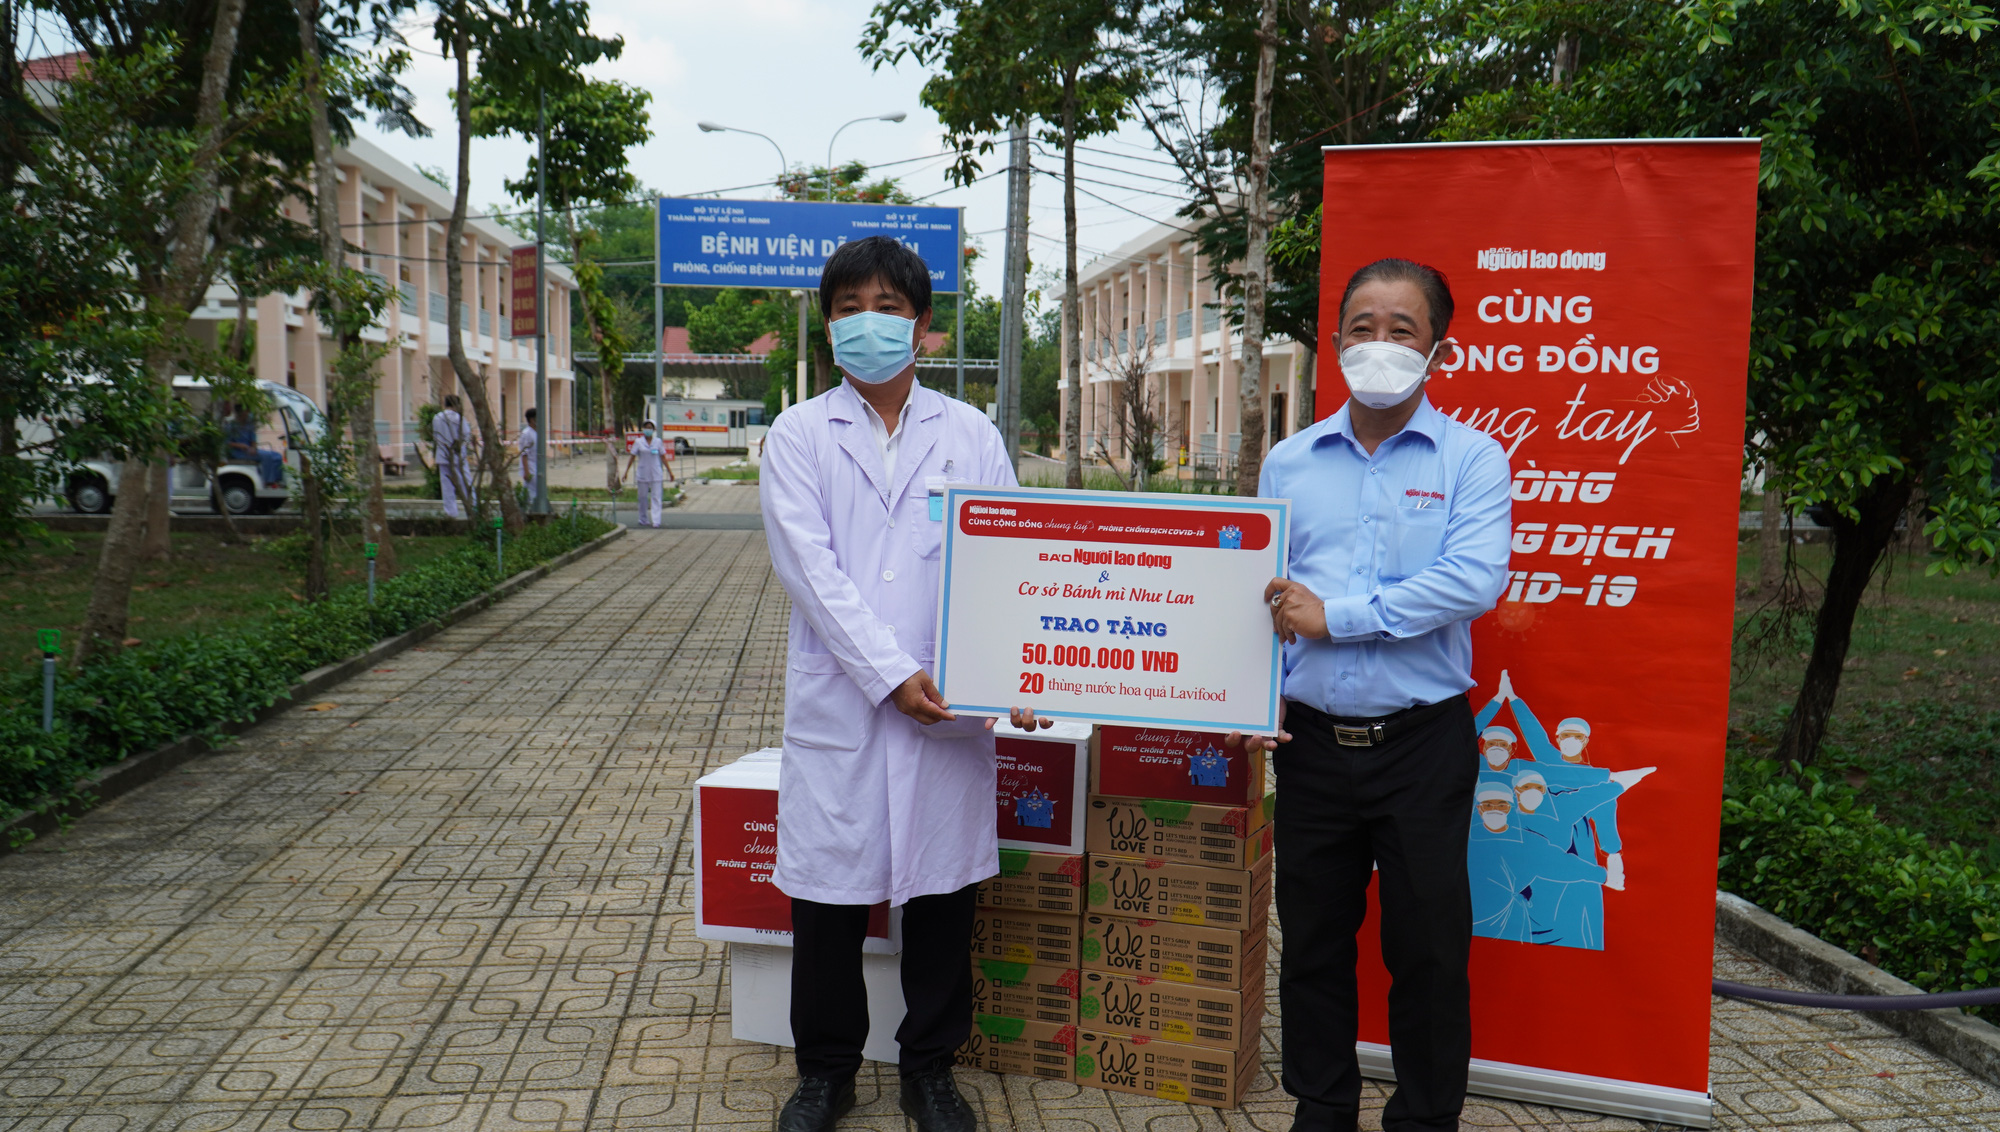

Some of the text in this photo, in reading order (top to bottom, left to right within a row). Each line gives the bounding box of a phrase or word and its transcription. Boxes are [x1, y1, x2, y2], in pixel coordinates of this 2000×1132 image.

[667, 214, 696, 222] THÀNH
[698, 214, 716, 222] PHỐ
[732, 216, 746, 224] CHÍ
[694, 206, 706, 214] BỘ
[721, 206, 744, 215] LỆNH
[914, 222, 928, 230] CHÍ
[701, 231, 759, 258] BỆNH
[766, 234, 815, 260] VIỆN
[673, 261, 710, 274] PHÒNG,
[712, 261, 747, 274] CHỐNG
[750, 264, 777, 276] BỆNH
[780, 264, 805, 276] VIÊM
[1530, 250, 1558, 269] lao
[1478, 288, 1592, 324] CÙNG
[1439, 334, 1660, 379] ỘNG ĐỒNG
[1556, 383, 1656, 465] tay
[1510, 460, 1616, 504] ÒNG
[988, 506, 1000, 515] lao
[968, 517, 992, 526] CÙNG
[993, 518, 1016, 528] CỘNG
[1018, 519, 1042, 528] ĐỒNG
[1044, 518, 1072, 532] chung
[1073, 520, 1088, 534] tay
[1098, 524, 1124, 532] PHÒNG
[1125, 525, 1150, 534] CHỐNG
[1150, 528, 1168, 536] DỊCH
[1549, 524, 1676, 566] DỊCH
[1114, 550, 1136, 566] lao
[1098, 570, 1110, 583] &
[1018, 581, 1194, 604] Cơ sở Bánh mì Như Lan
[1506, 570, 1638, 608] ID-19
[1040, 616, 1167, 640] TRAO TẶNG
[1022, 642, 1179, 673] 50.000.000 VNĐ
[1019, 672, 1226, 702] 20 thùng nước hoa quả Lavifood
[1135, 728, 1194, 748] chung tay
[1140, 745, 1164, 754] CHỐNG
[996, 760, 1042, 772] ỘNG ĐỒNG
[1001, 774, 1020, 790] tay
[744, 820, 776, 832] CÙNG
[1106, 807, 1149, 840] We
[744, 836, 778, 854] chun
[1111, 840, 1146, 853] LOVE
[716, 859, 776, 870] PHÒNG CHỐN
[1109, 866, 1154, 900] We
[1114, 899, 1150, 912] LOVE
[1102, 923, 1146, 958] We
[1108, 956, 1142, 970] LOVE
[1101, 981, 1144, 1016] We
[1106, 1013, 1141, 1028] LOVE
[956, 1055, 982, 1068] OVE
[1097, 1041, 1140, 1076] We
[1102, 1072, 1136, 1088] LOVE
[1169, 1070, 1188, 1078] YELLOW
